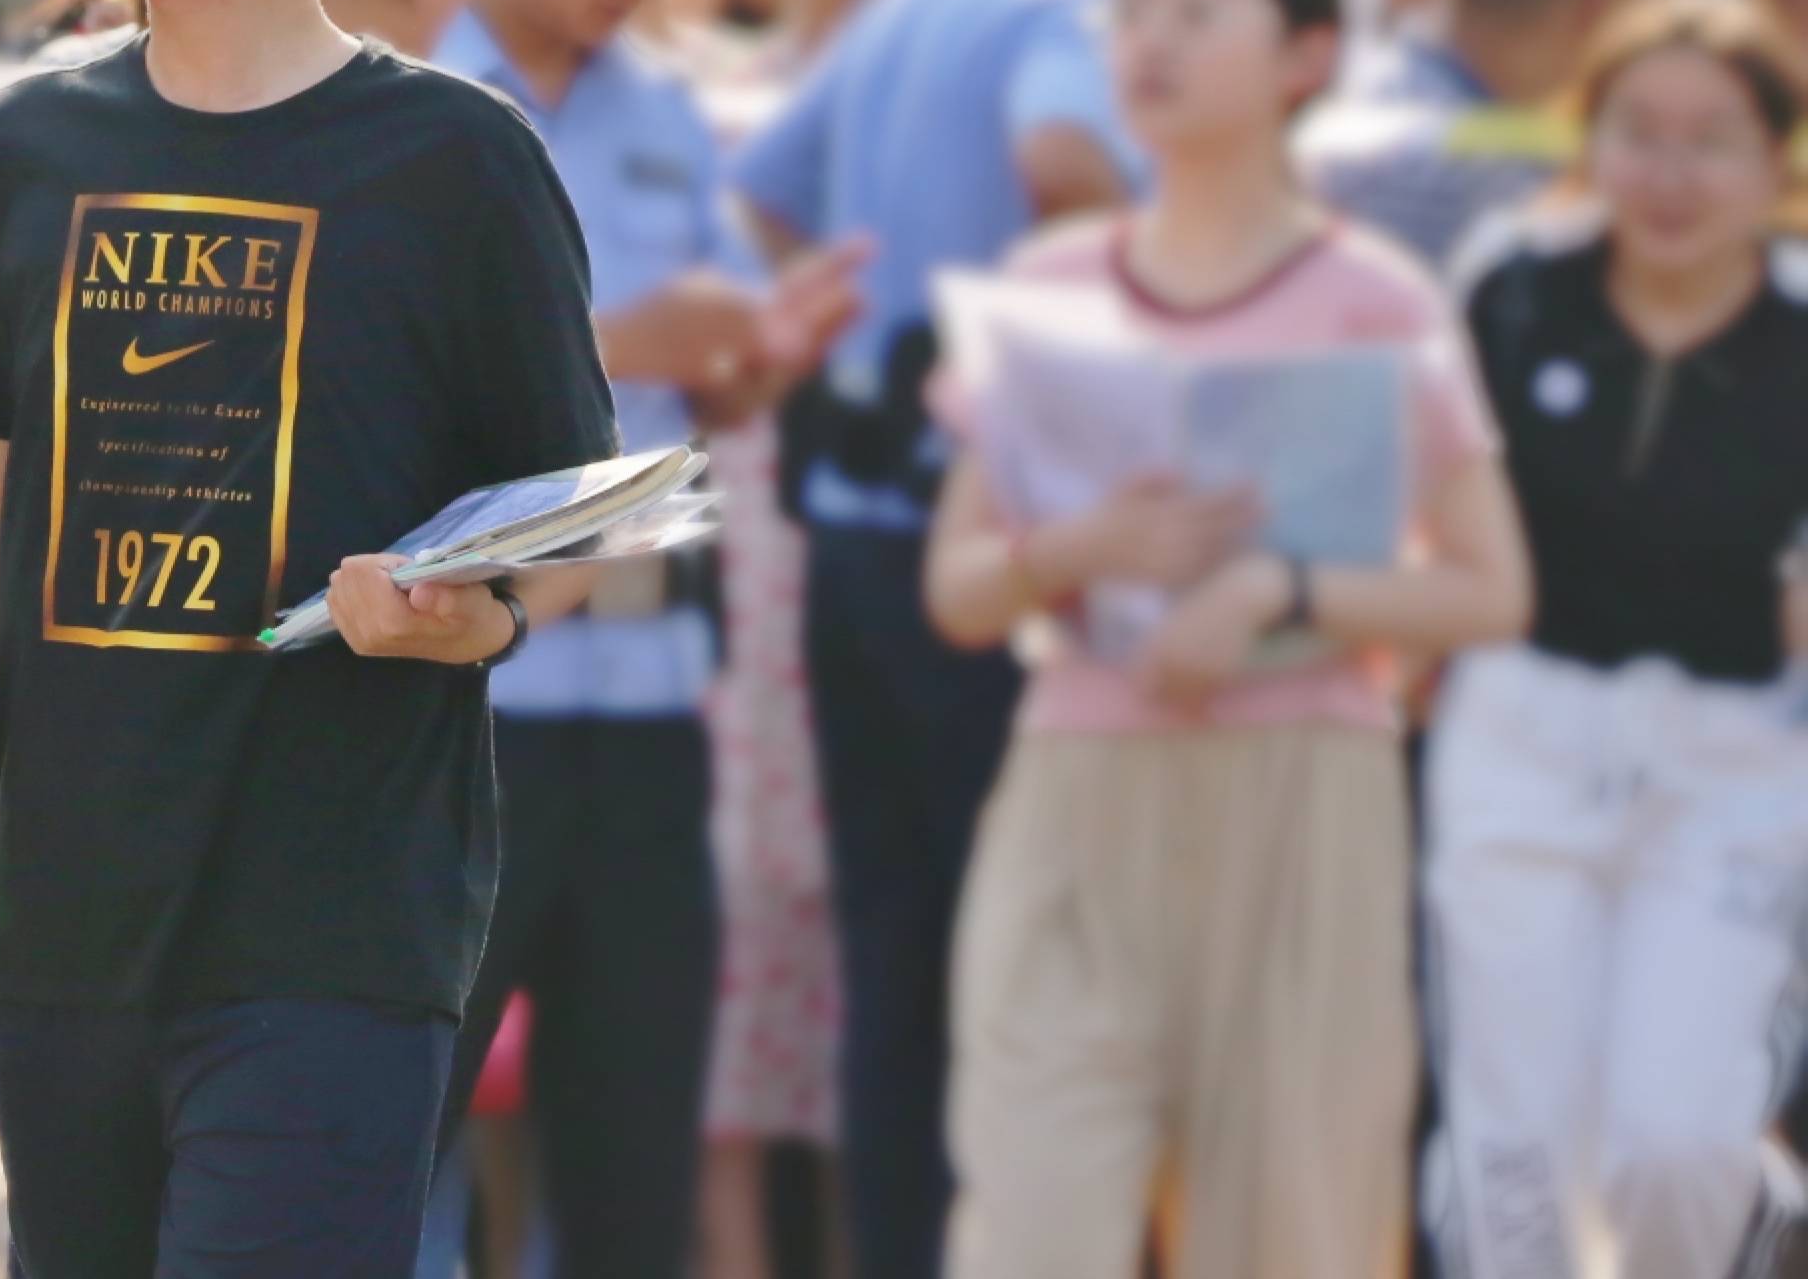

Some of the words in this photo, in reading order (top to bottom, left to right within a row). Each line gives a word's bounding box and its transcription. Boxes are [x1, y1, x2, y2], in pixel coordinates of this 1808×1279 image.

[83, 230, 283, 292] NIKE
[81, 289, 147, 311] WORLD
[158, 291, 275, 320] CHAMPIONS
[80, 397, 161, 414] Engineered
[214, 403, 263, 420] Exact
[209, 445, 230, 462] of
[182, 485, 253, 503] Athletes
[93, 528, 222, 612] 1972
